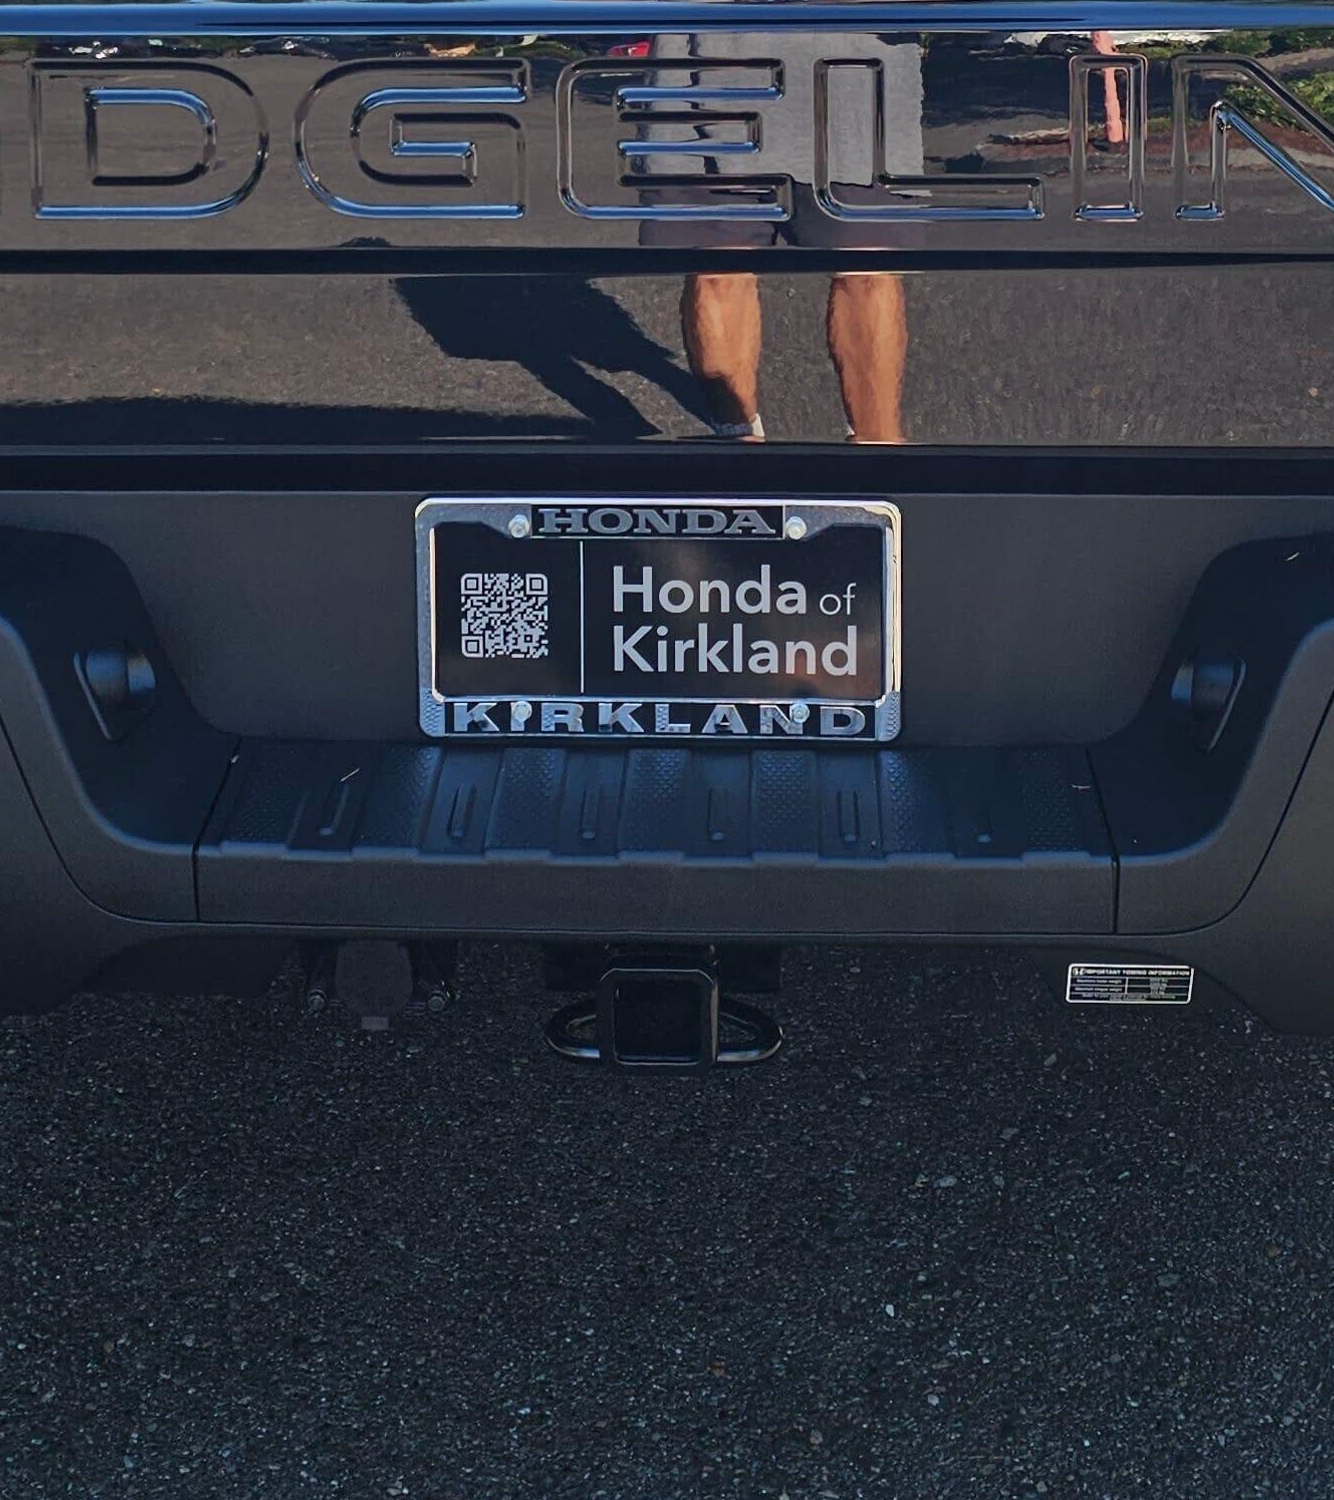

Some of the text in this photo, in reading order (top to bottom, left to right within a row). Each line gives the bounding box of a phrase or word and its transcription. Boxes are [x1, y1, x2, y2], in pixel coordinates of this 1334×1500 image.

[536, 507, 777, 536] HONDA
[613, 564, 857, 616] Honda of
[613, 622, 858, 677] Kirkland
[453, 701, 867, 736] KIRKLAND
